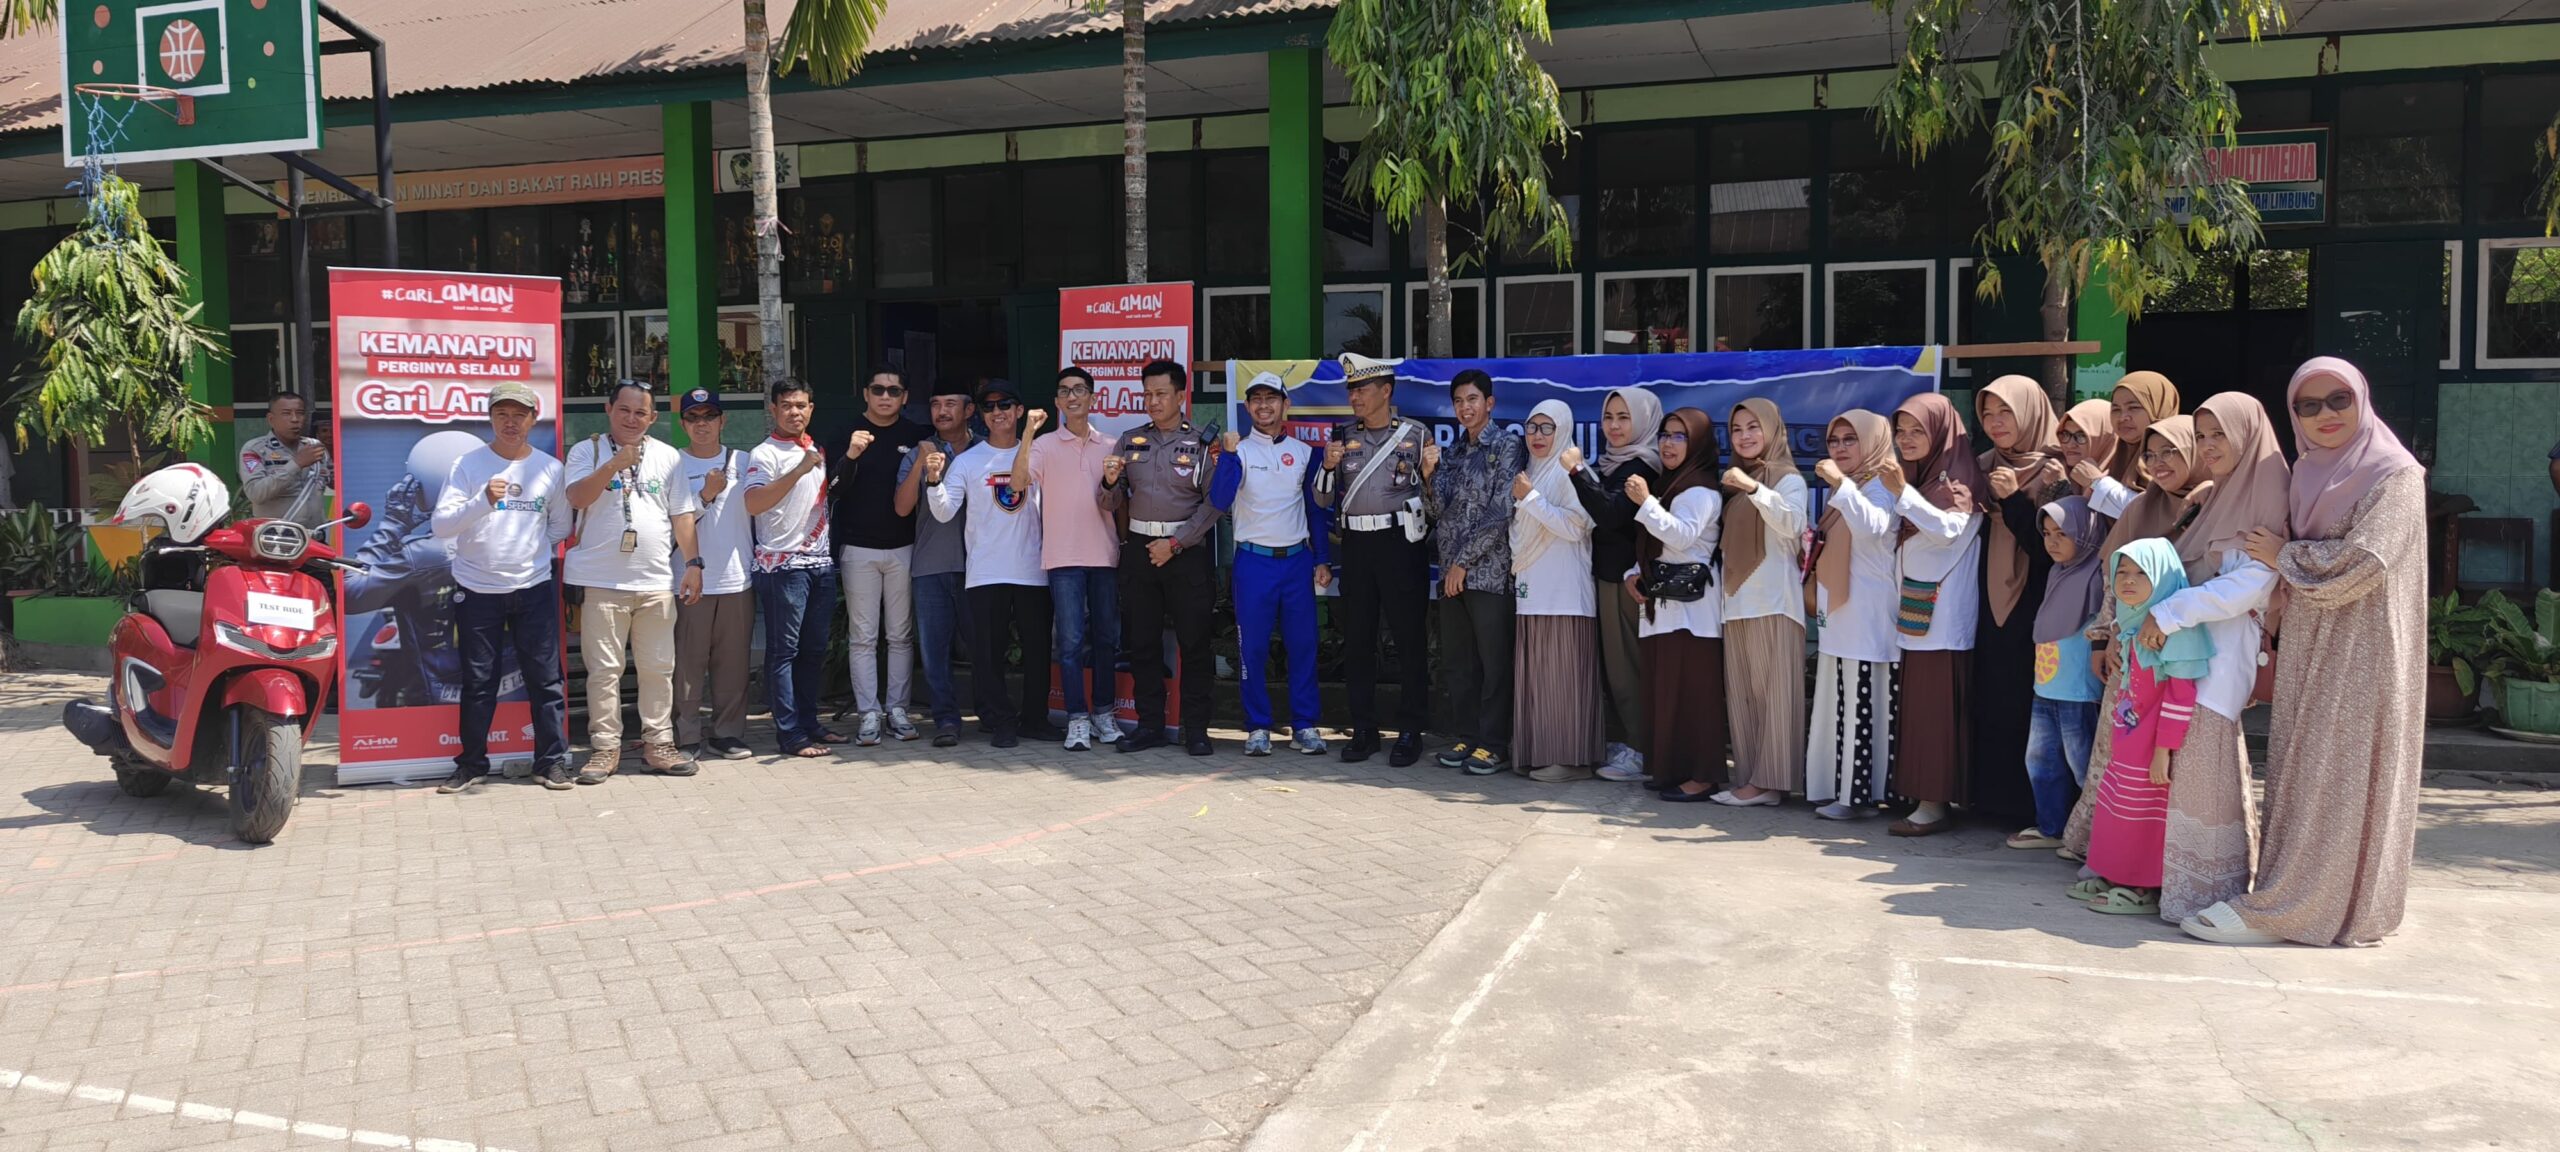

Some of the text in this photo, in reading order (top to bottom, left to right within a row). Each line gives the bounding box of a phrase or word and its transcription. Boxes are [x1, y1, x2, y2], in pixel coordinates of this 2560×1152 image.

[2220, 143, 2317, 183] MULTIMEDIA
[412, 181, 465, 201] MINAT
[469, 180, 504, 198] DAN
[508, 174, 567, 194] BAKAT
[570, 171, 613, 191] RAIH
[618, 167, 665, 187] PRES
[2270, 191, 2316, 210] LIMBUNG
[360, 332, 535, 359] KEMANAPUN
[1071, 340, 1174, 361] KEMANAPUN
[378, 360, 521, 377] PERGINYA SELALU
[362, 388, 490, 417] Cari_Am
[259, 602, 304, 615] TEST RIDE
[354, 737, 398, 747] AHM
